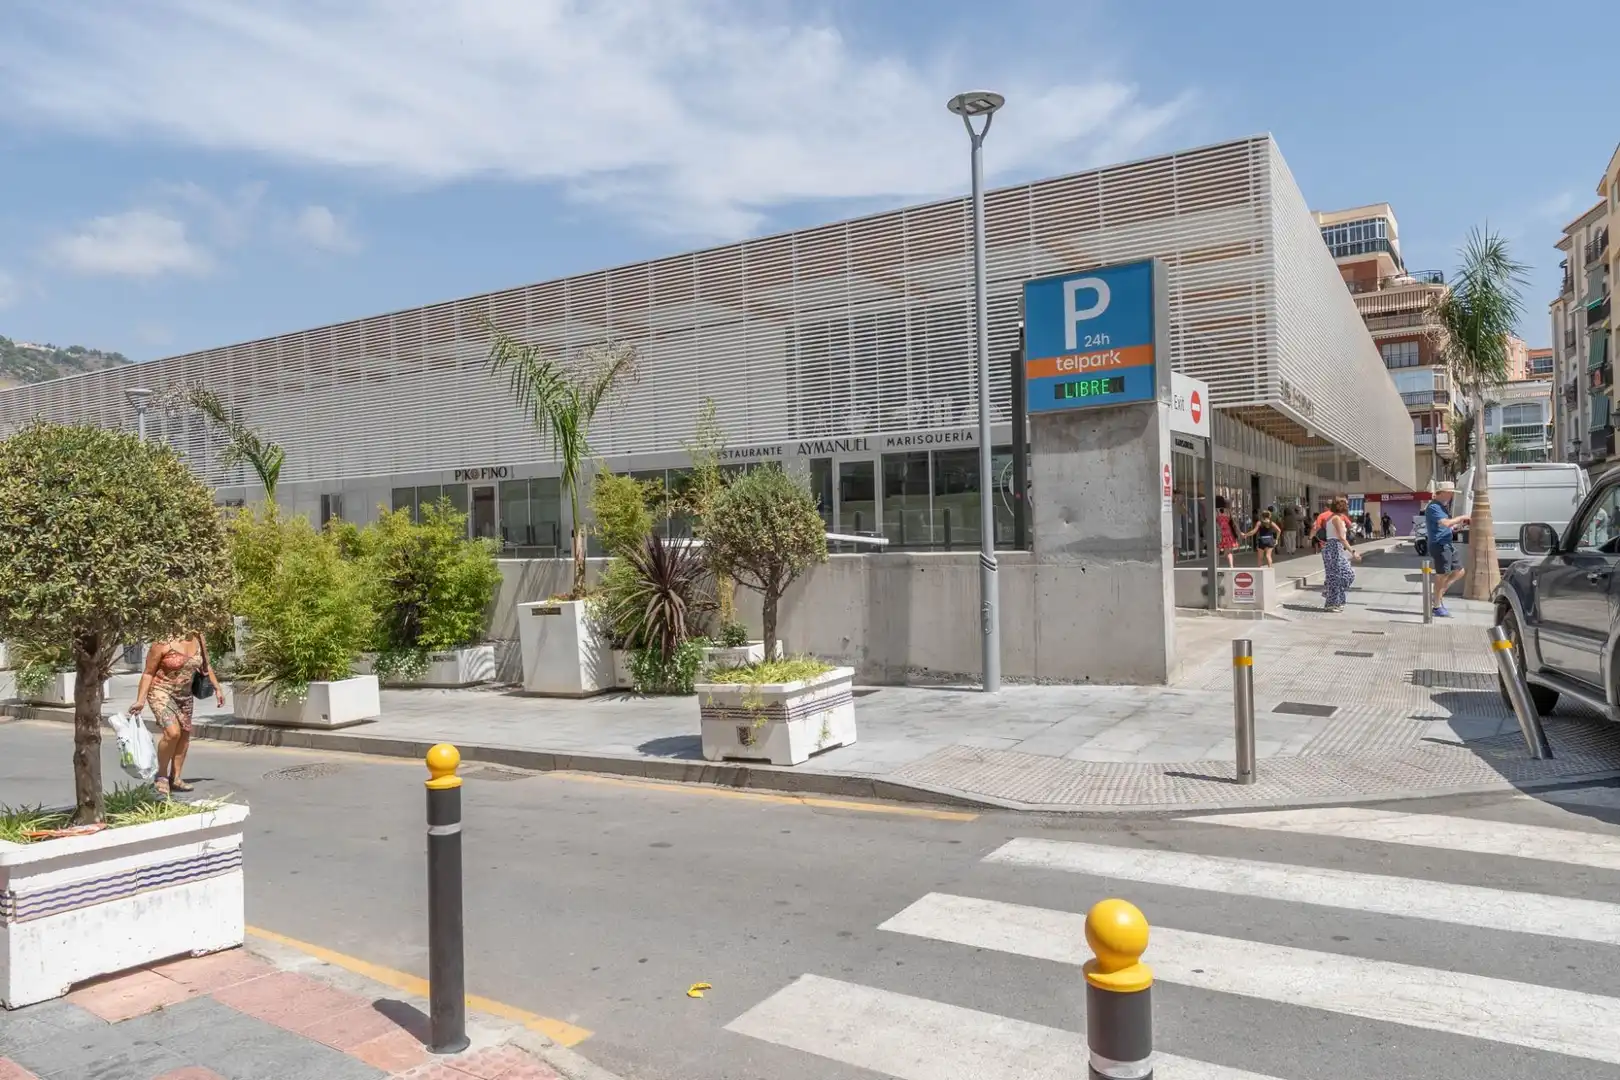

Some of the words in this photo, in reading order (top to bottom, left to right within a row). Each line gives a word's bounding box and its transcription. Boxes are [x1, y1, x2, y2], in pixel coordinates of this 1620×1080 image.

[1063, 277, 1111, 350] P
[1084, 333, 1110, 348] 24h
[1056, 350, 1121, 372] telpark
[1065, 379, 1110, 399] LIBRE
[711, 446, 783, 460] ESTAURANTE
[796, 437, 871, 456] AYMANUEL
[886, 429, 973, 447] MARISQUERÍA
